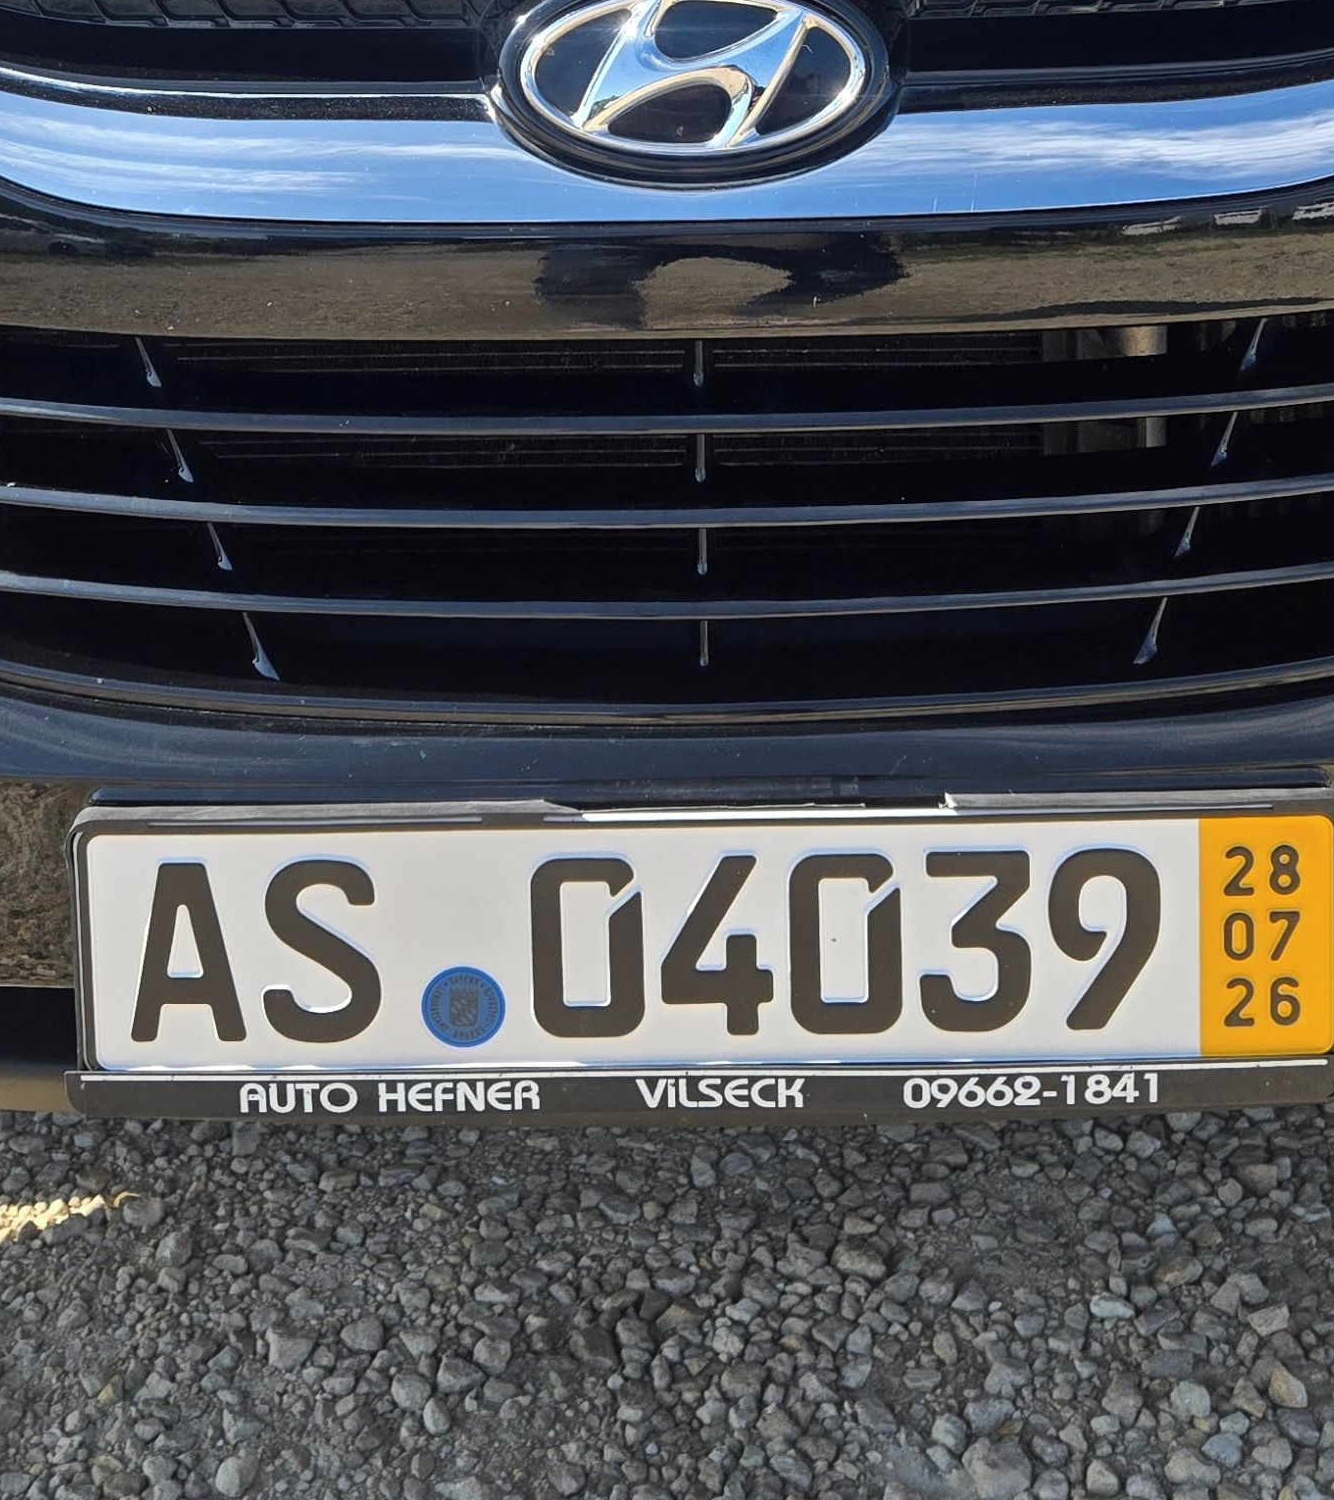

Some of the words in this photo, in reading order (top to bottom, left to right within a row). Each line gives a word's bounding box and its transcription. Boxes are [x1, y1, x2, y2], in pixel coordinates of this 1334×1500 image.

[1223, 845, 1301, 896] 28
[131, 859, 382, 1044] AS
[530, 847, 1161, 1038] 04039
[1223, 911, 1301, 961] 07
[1223, 977, 1301, 1027] 26
[239, 1082, 358, 1114] AUTO
[377, 1080, 541, 1113] HEFNER
[635, 1077, 805, 1109] VILSECK
[902, 1072, 1159, 1109] 09662-1841
